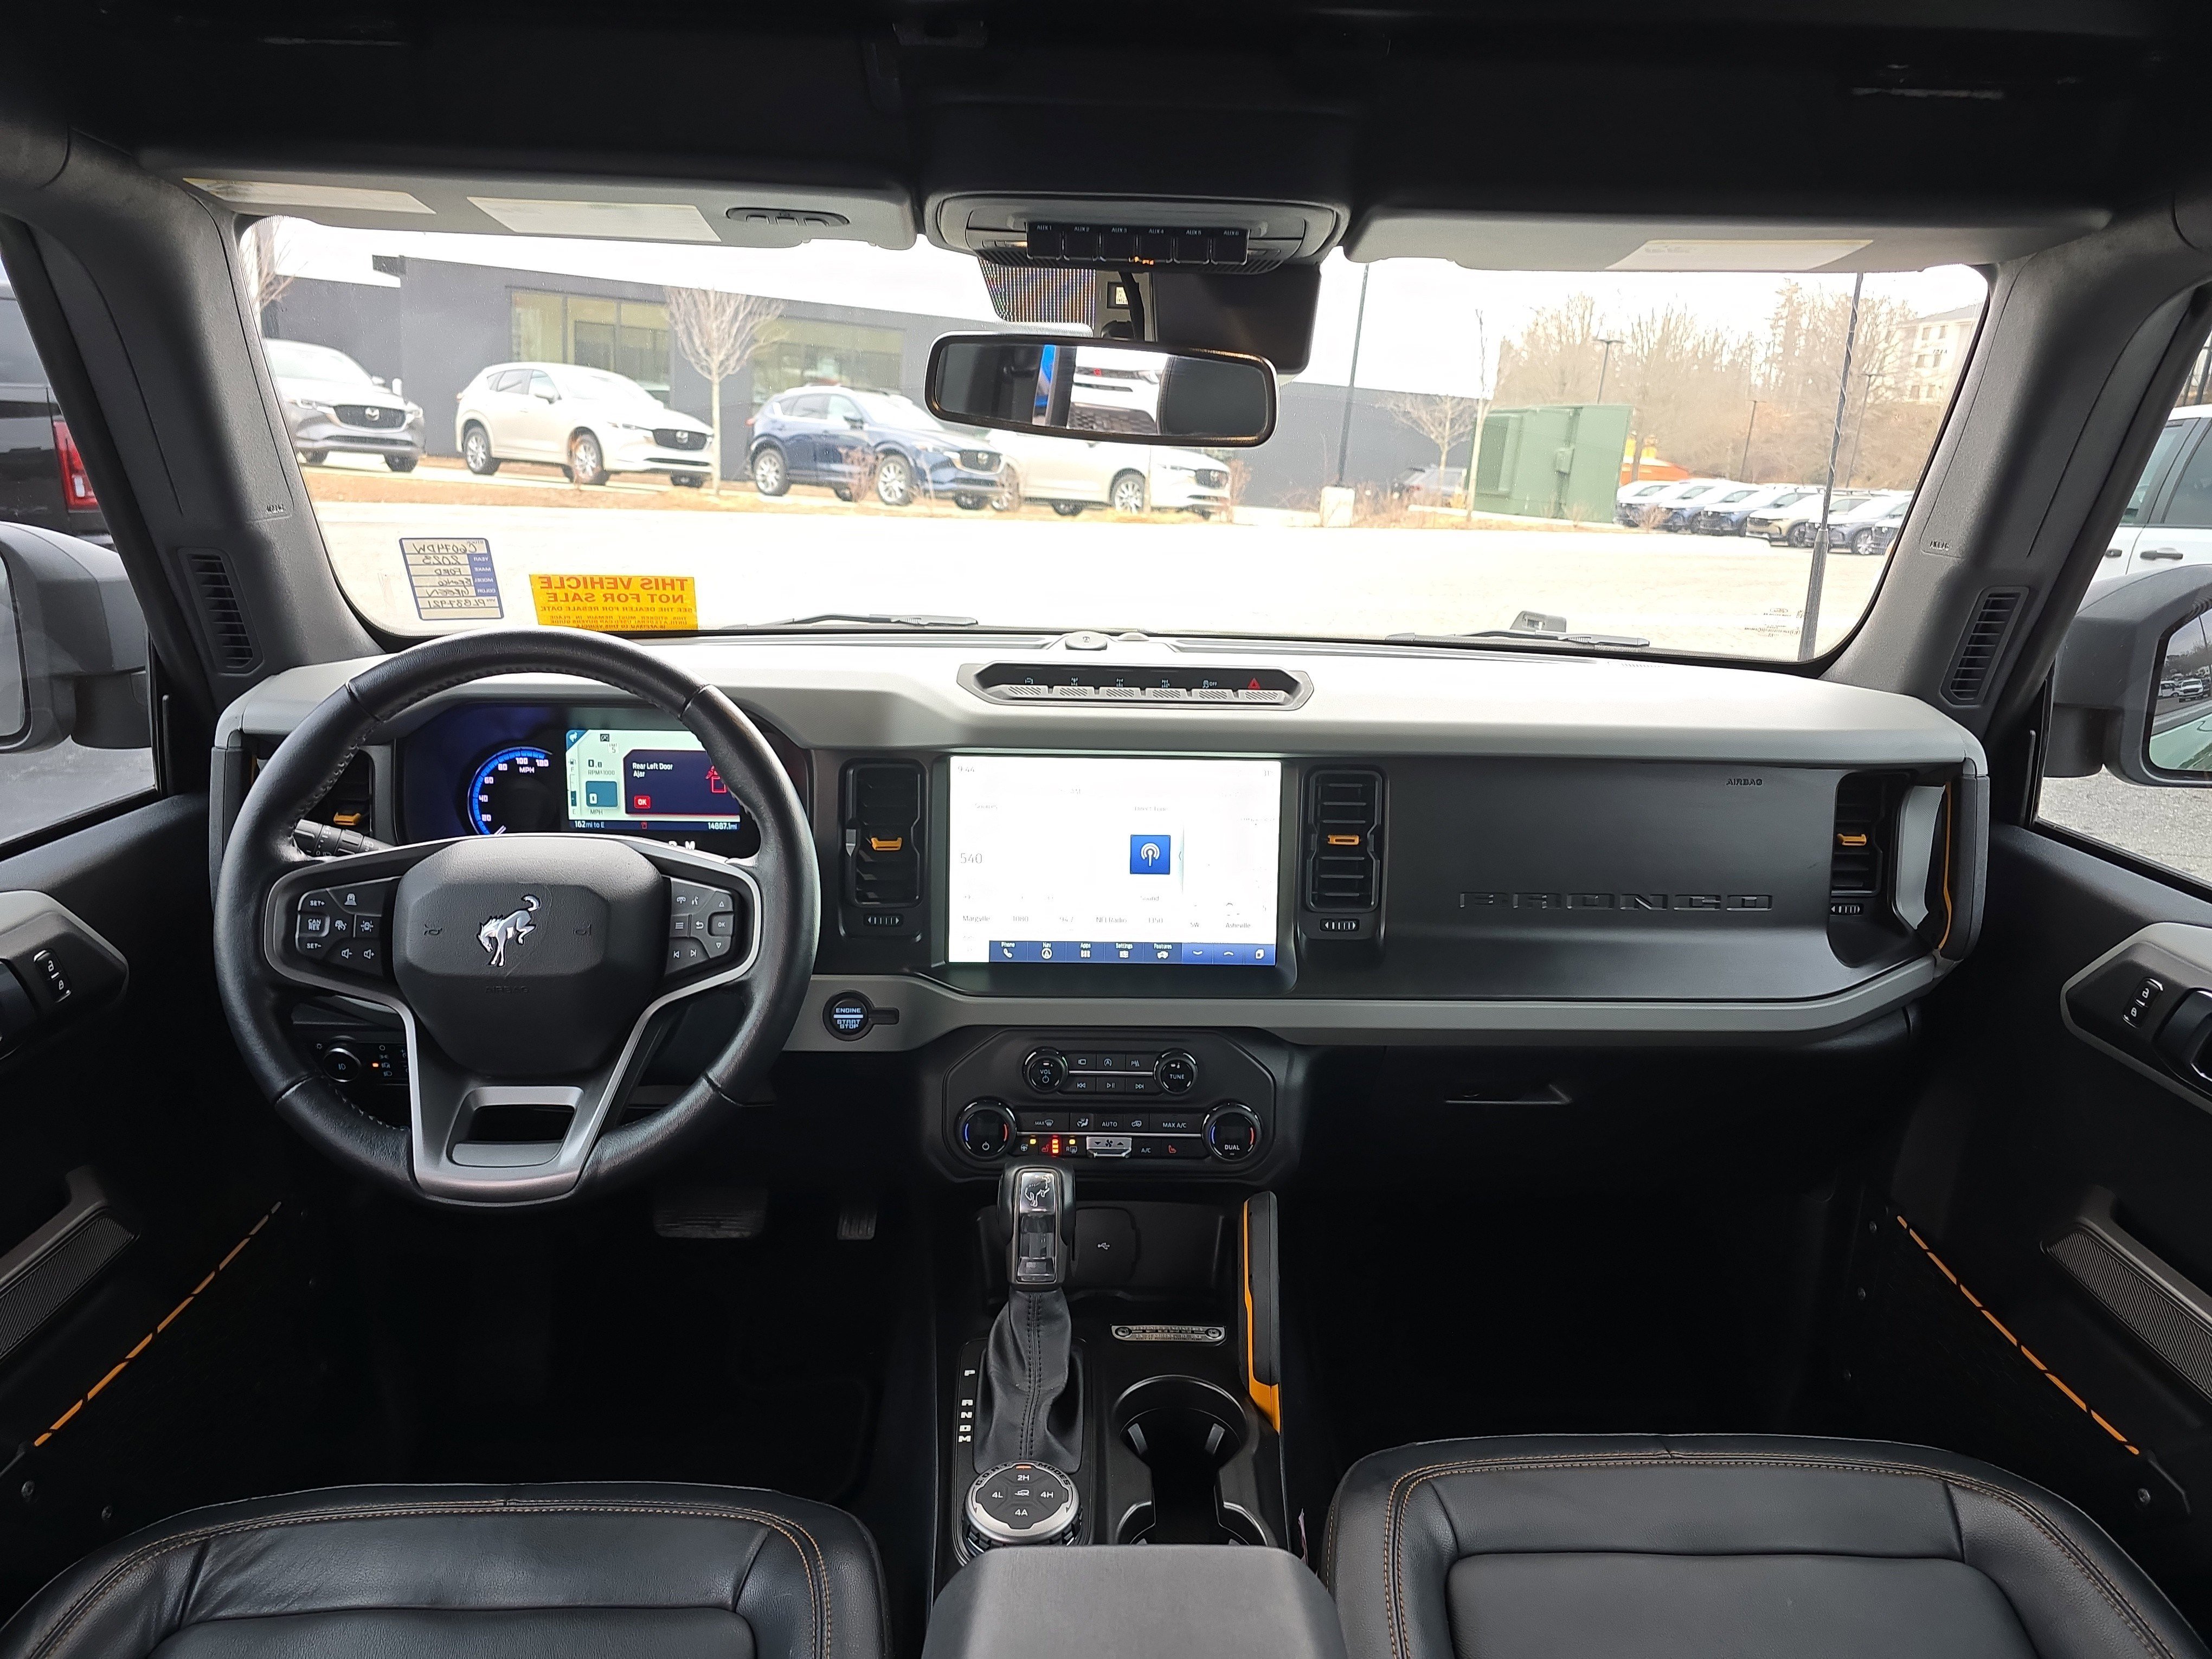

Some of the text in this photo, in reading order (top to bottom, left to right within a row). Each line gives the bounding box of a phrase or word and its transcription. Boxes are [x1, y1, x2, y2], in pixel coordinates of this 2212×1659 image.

[589, 793, 597, 804] 0
[685, 841, 696, 850] M
[960, 852, 983, 864] 540
[1459, 892, 1772, 911] BRONCO
[1038, 1463, 1071, 1486] MODES
